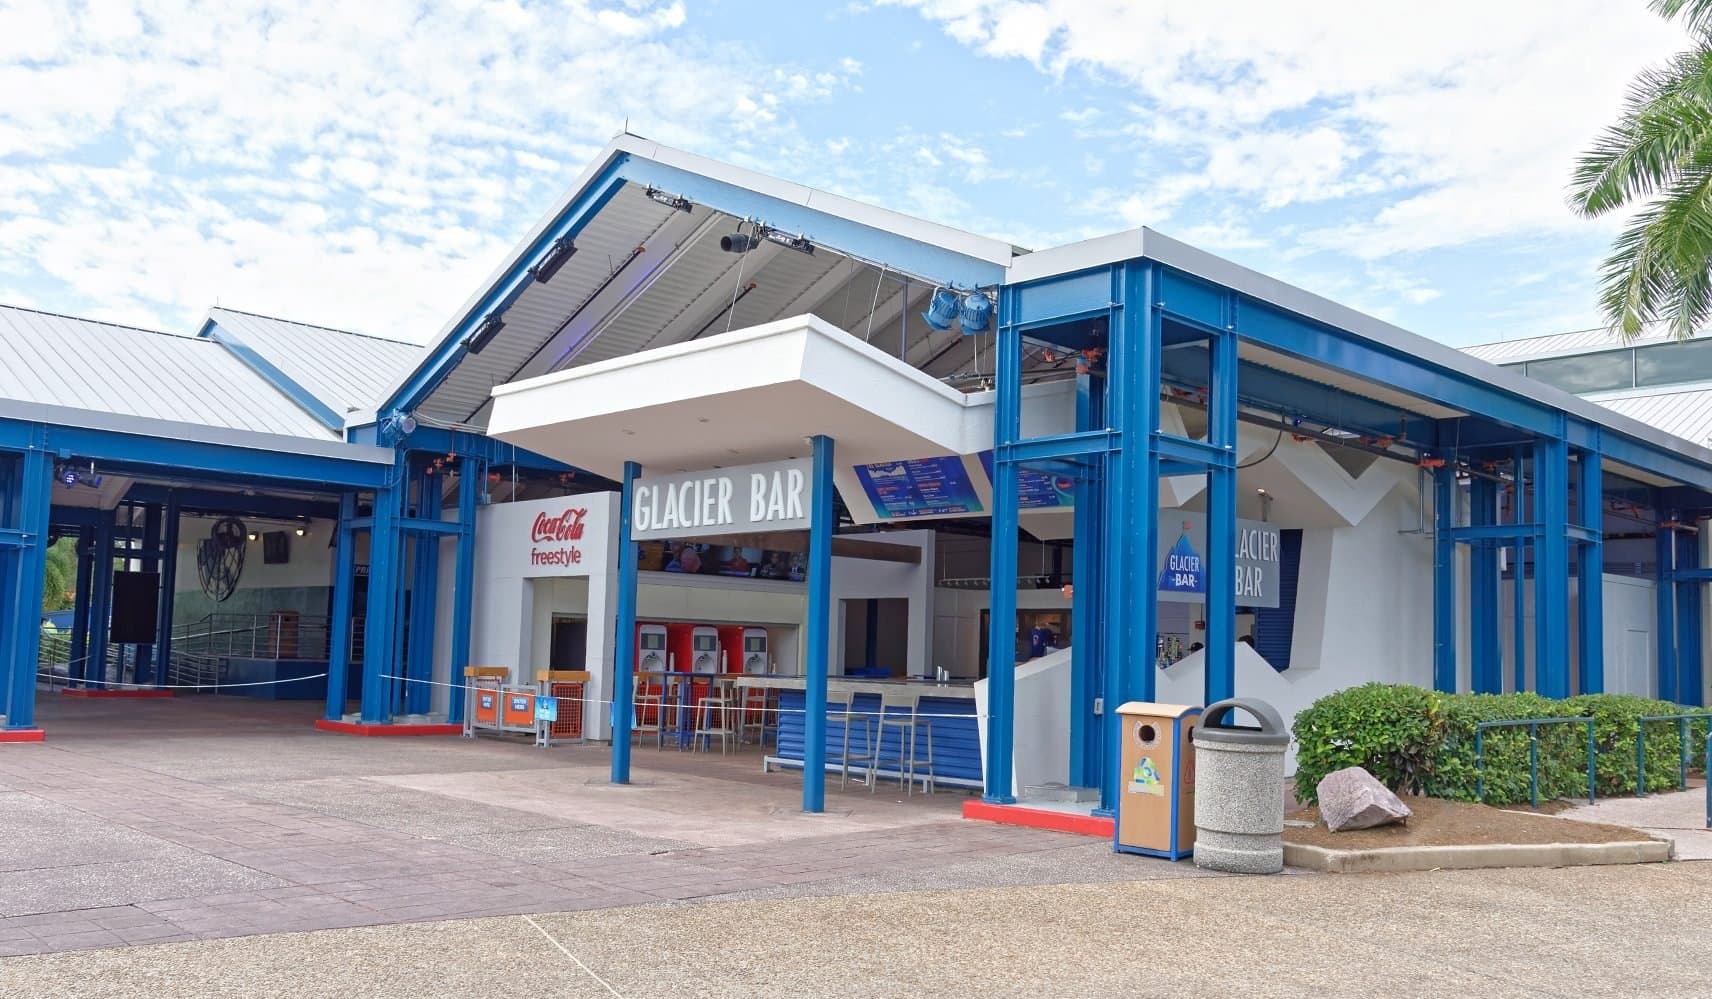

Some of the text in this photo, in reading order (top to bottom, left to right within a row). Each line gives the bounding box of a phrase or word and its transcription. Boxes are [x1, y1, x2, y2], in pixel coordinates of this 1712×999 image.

[634, 469, 804, 532] GLACIER BAR
[531, 545, 582, 568] freestyle
[1235, 528, 1279, 562] ACIER
[1170, 554, 1200, 573] GLACIER
[1235, 565, 1263, 597] BAR
